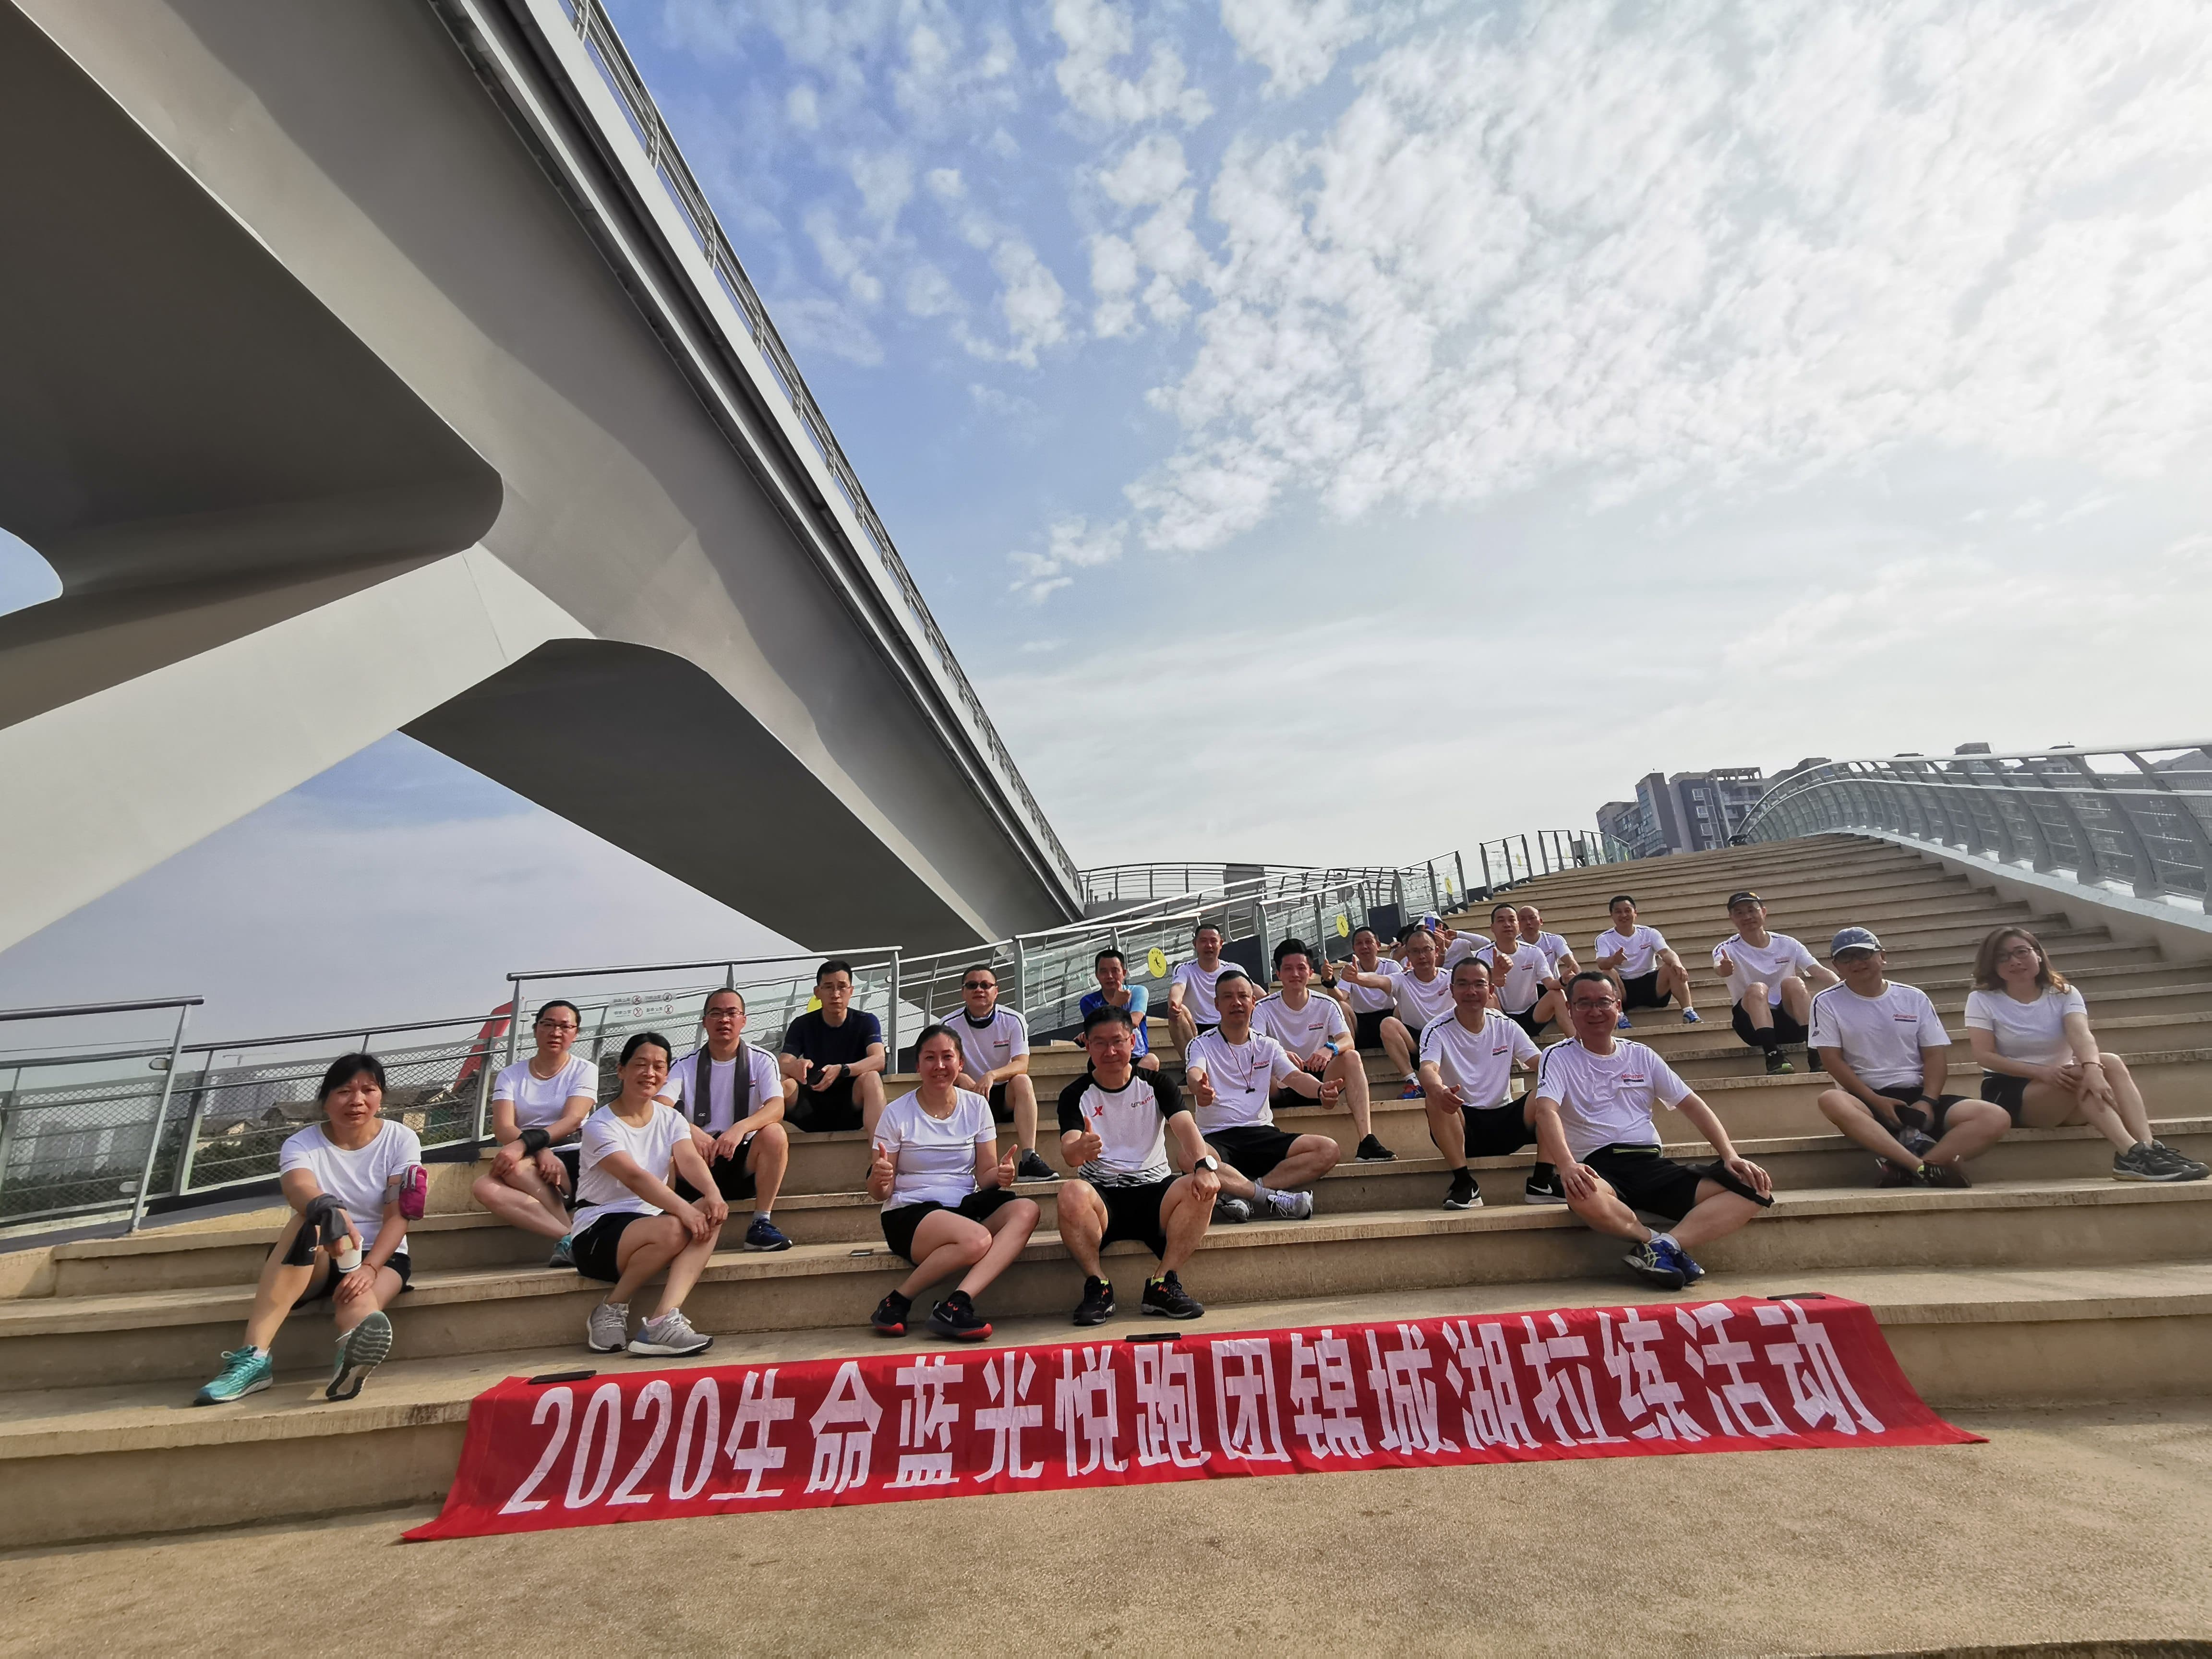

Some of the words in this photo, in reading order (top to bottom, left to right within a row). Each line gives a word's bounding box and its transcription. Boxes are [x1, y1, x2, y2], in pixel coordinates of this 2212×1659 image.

[499, 1299, 1885, 1514] 2020生命蓝光悦跑团锦城湖拉练活动
